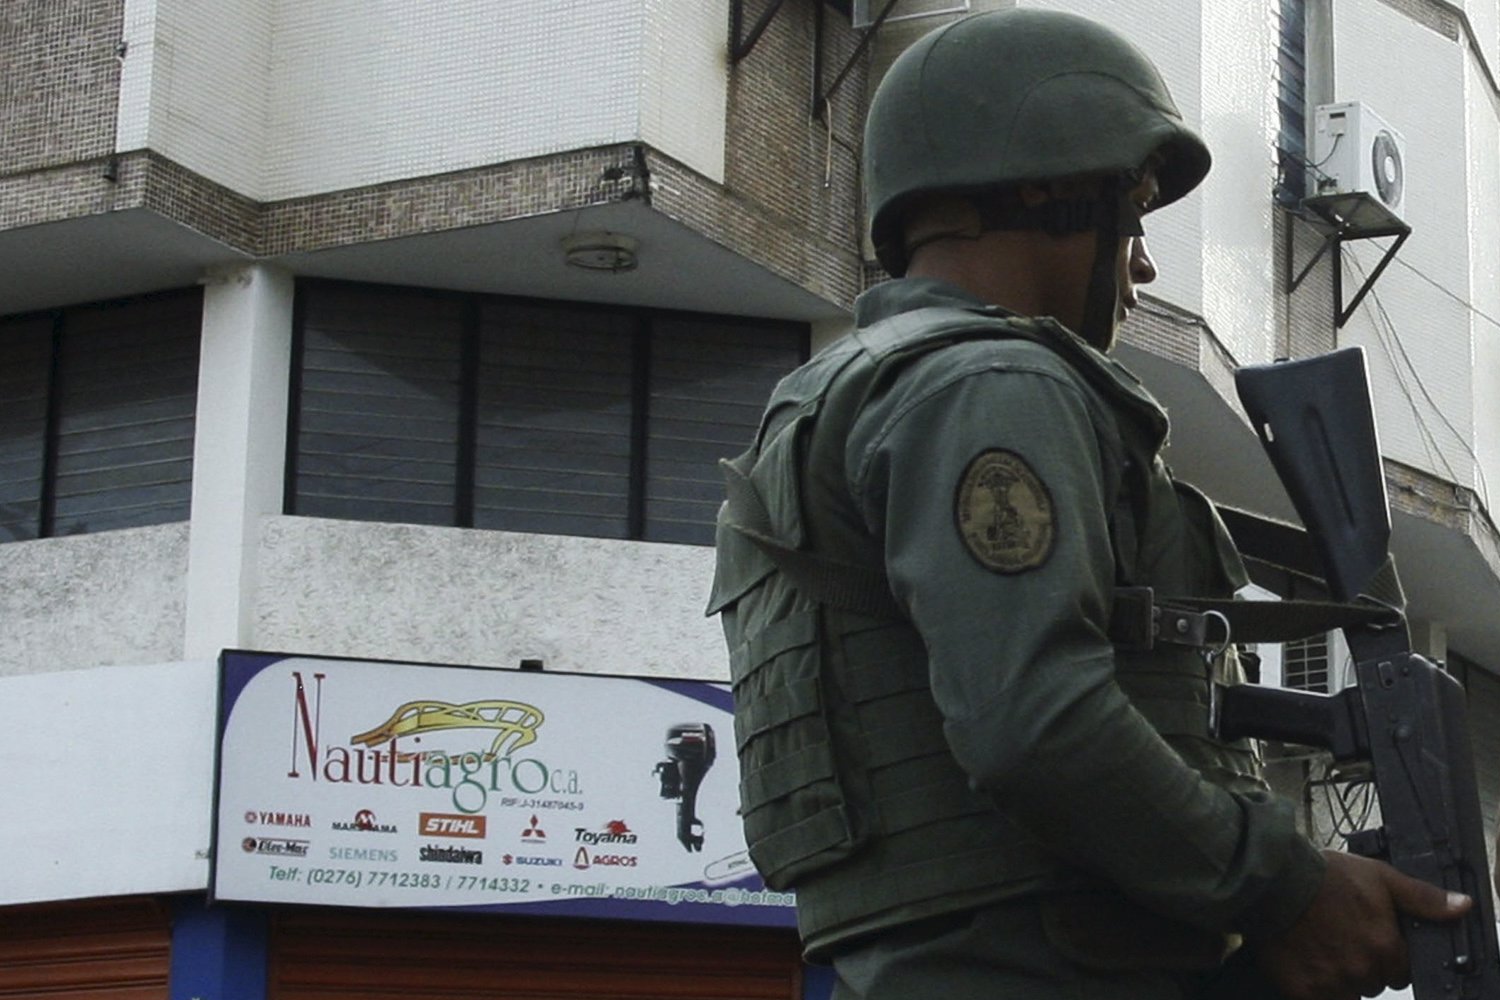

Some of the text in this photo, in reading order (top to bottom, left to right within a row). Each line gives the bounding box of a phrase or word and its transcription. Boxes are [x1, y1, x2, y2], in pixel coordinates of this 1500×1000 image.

[287, 671, 551, 815] Nautiagro
[259, 811, 312, 827] YAMAHA
[424, 817, 480, 835] STIHL
[573, 827, 638, 846] Toyama
[328, 846, 399, 862] SIEMENS
[419, 844, 483, 865] shindaiwa
[515, 855, 564, 867] SUZUKI
[592, 854, 638, 867] AGROS
[268, 865, 303, 881] Telf:
[306, 868, 362, 888] (0276)
[366, 871, 442, 889] 7712383
[456, 876, 530, 894] 7714332
[551, 881, 612, 897] e-mail:
